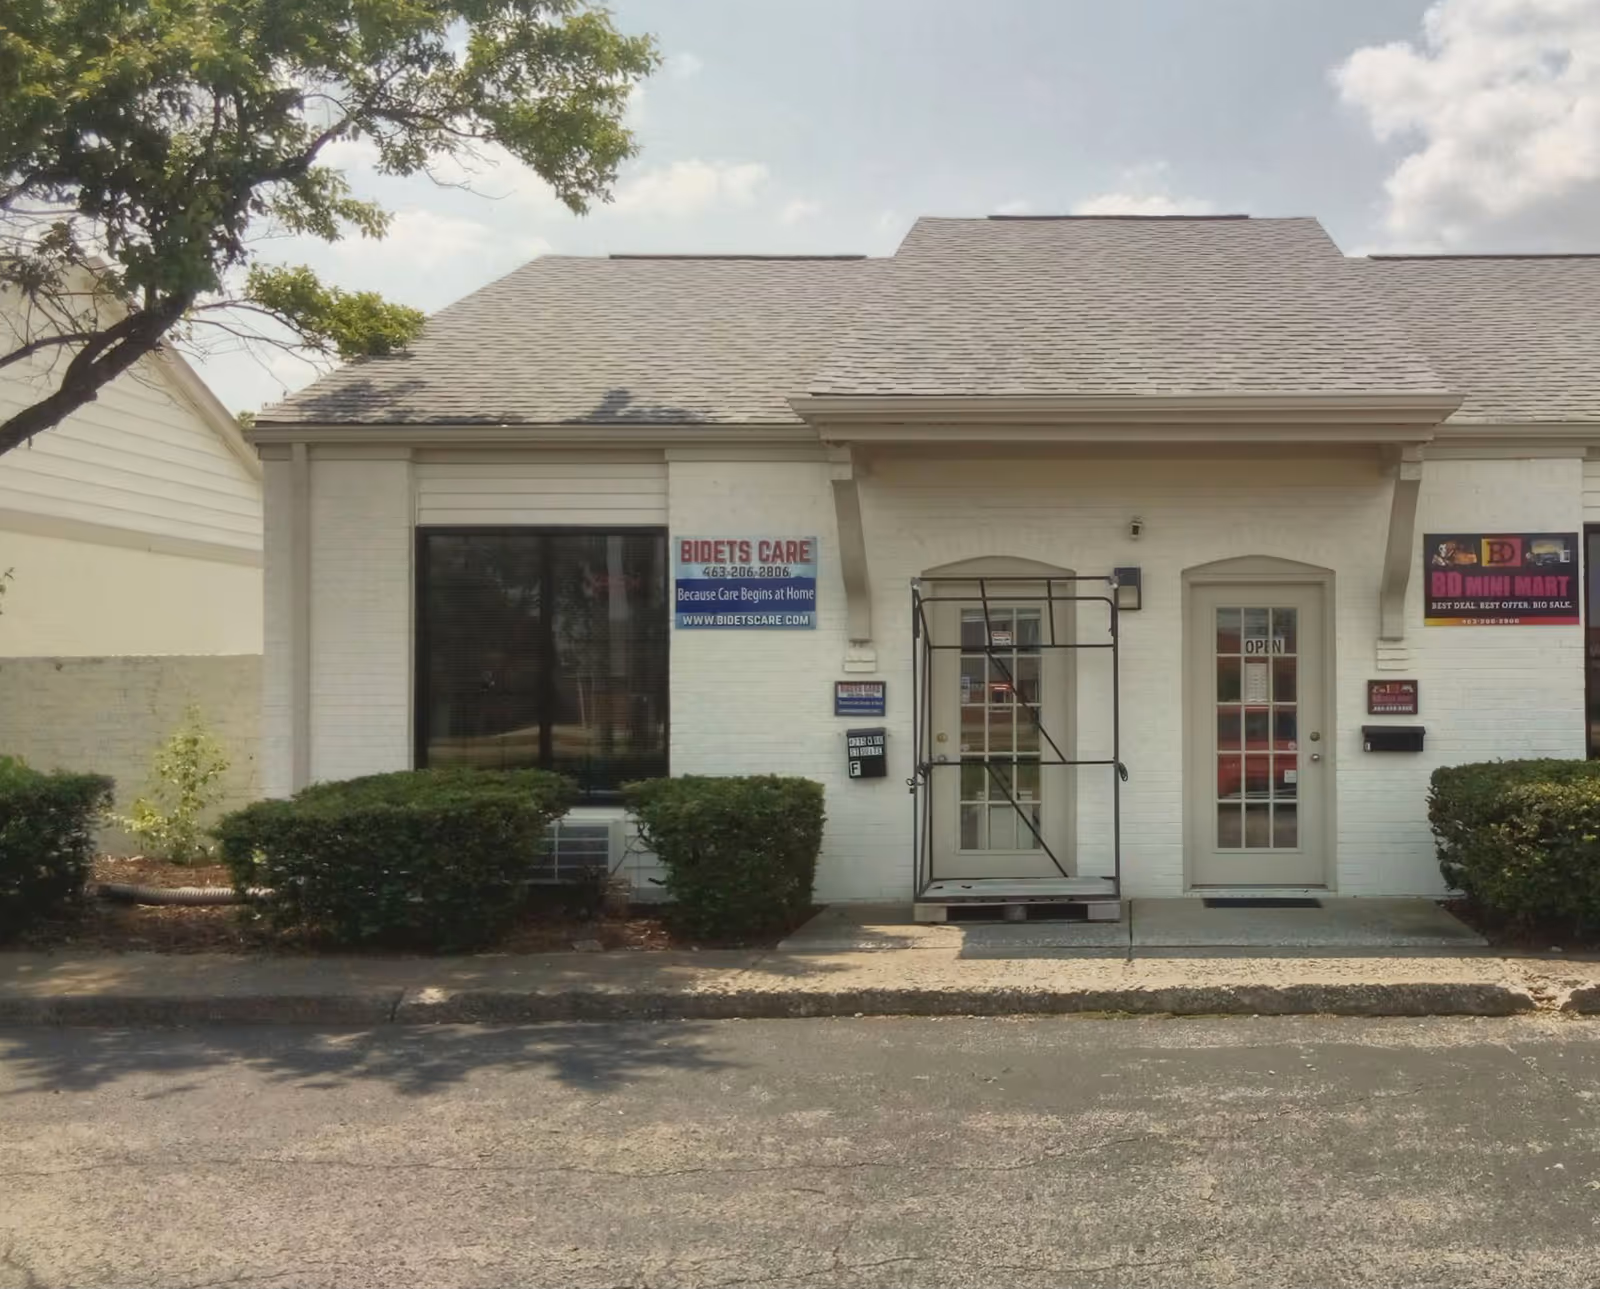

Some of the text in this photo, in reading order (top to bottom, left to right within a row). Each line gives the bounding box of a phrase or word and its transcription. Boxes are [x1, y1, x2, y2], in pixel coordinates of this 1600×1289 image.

[681, 540, 811, 563] BIDETS CARE
[703, 566, 790, 578] 463-206-2806
[1432, 571, 1570, 597] BD MINI MART
[678, 587, 814, 603] Because Care Begins at Home
[1432, 602, 1452, 610] BEST
[1454, 602, 1478, 610] DEAL.
[1502, 601, 1531, 609] OFFER.
[1549, 601, 1572, 609] SALE.
[682, 615, 809, 625] WWW.BIDETSCARE.COM
[1245, 639, 1281, 654] OPEN
[851, 762, 859, 774] F
